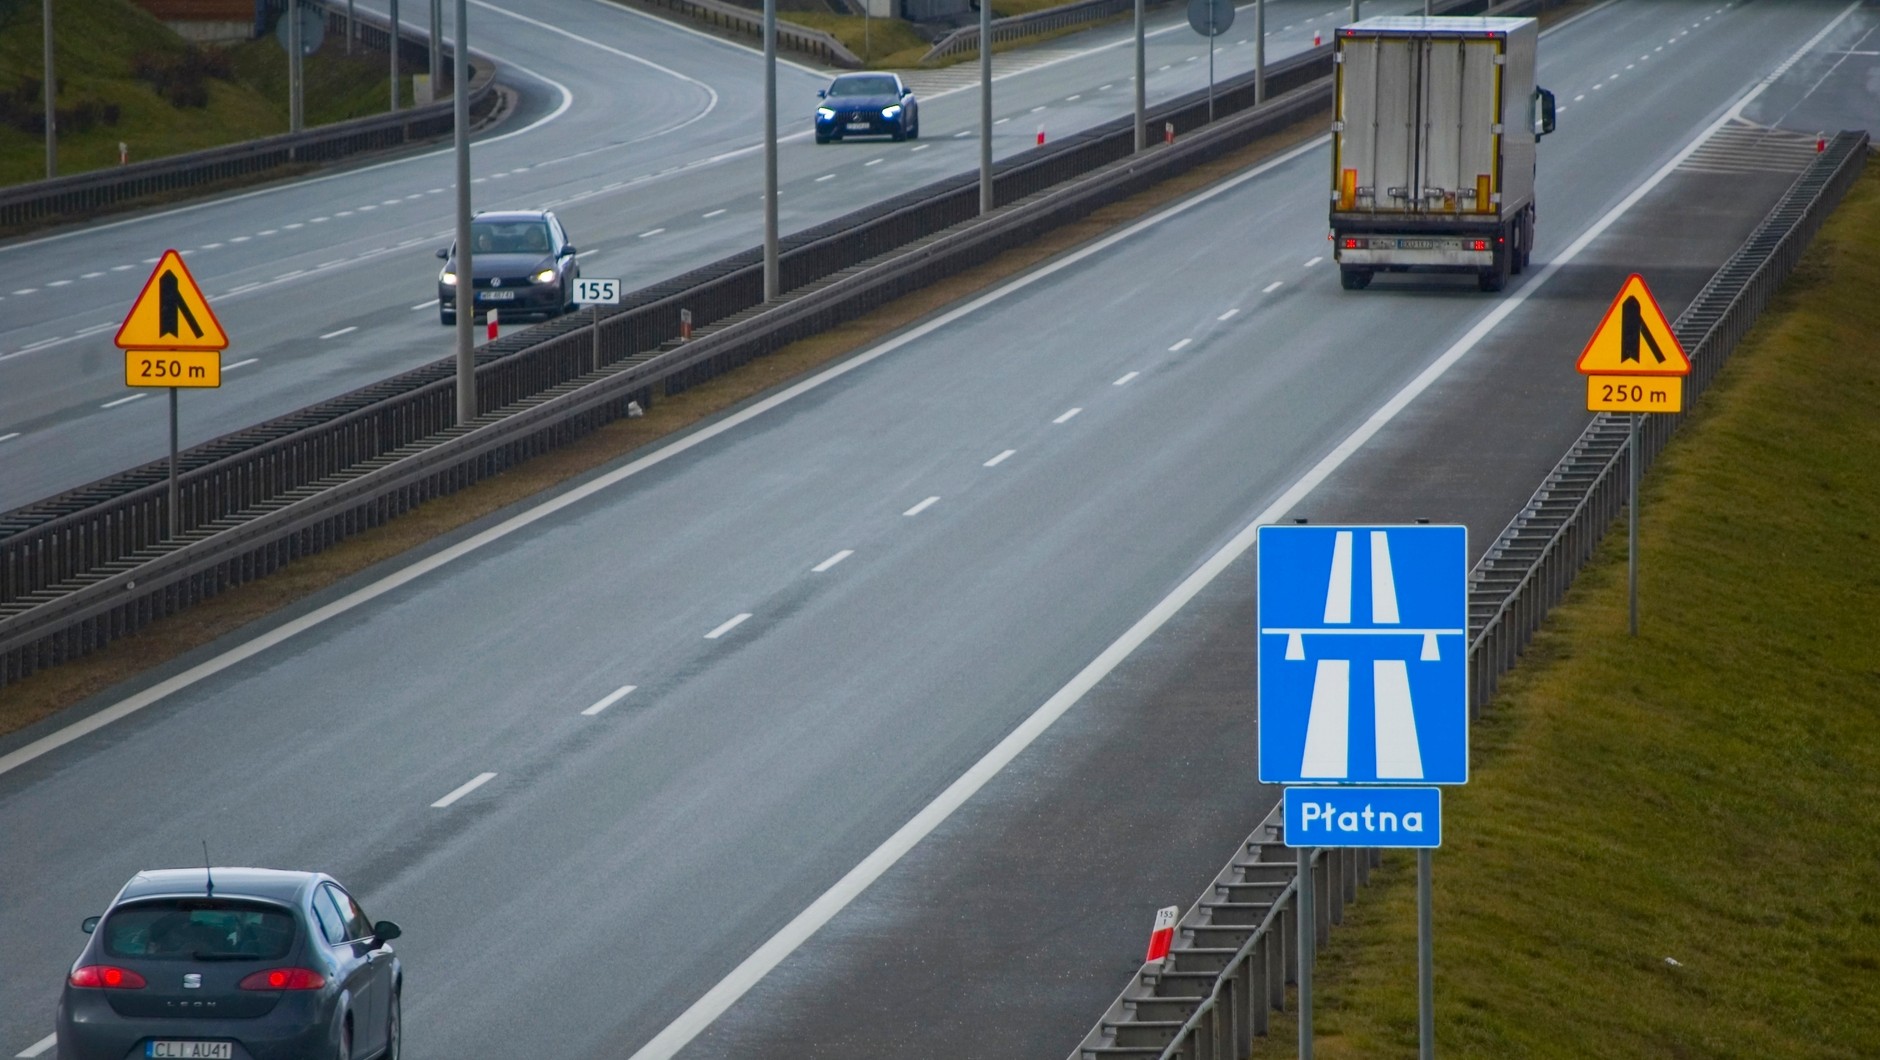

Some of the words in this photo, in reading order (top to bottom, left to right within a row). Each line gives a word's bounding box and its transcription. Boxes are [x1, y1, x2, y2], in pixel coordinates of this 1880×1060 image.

[579, 282, 614, 300] 155
[141, 359, 182, 378] 250
[188, 365, 205, 378] m
[1602, 384, 1643, 402] 250
[1650, 390, 1667, 402] m
[1301, 802, 1423, 832] Płatna
